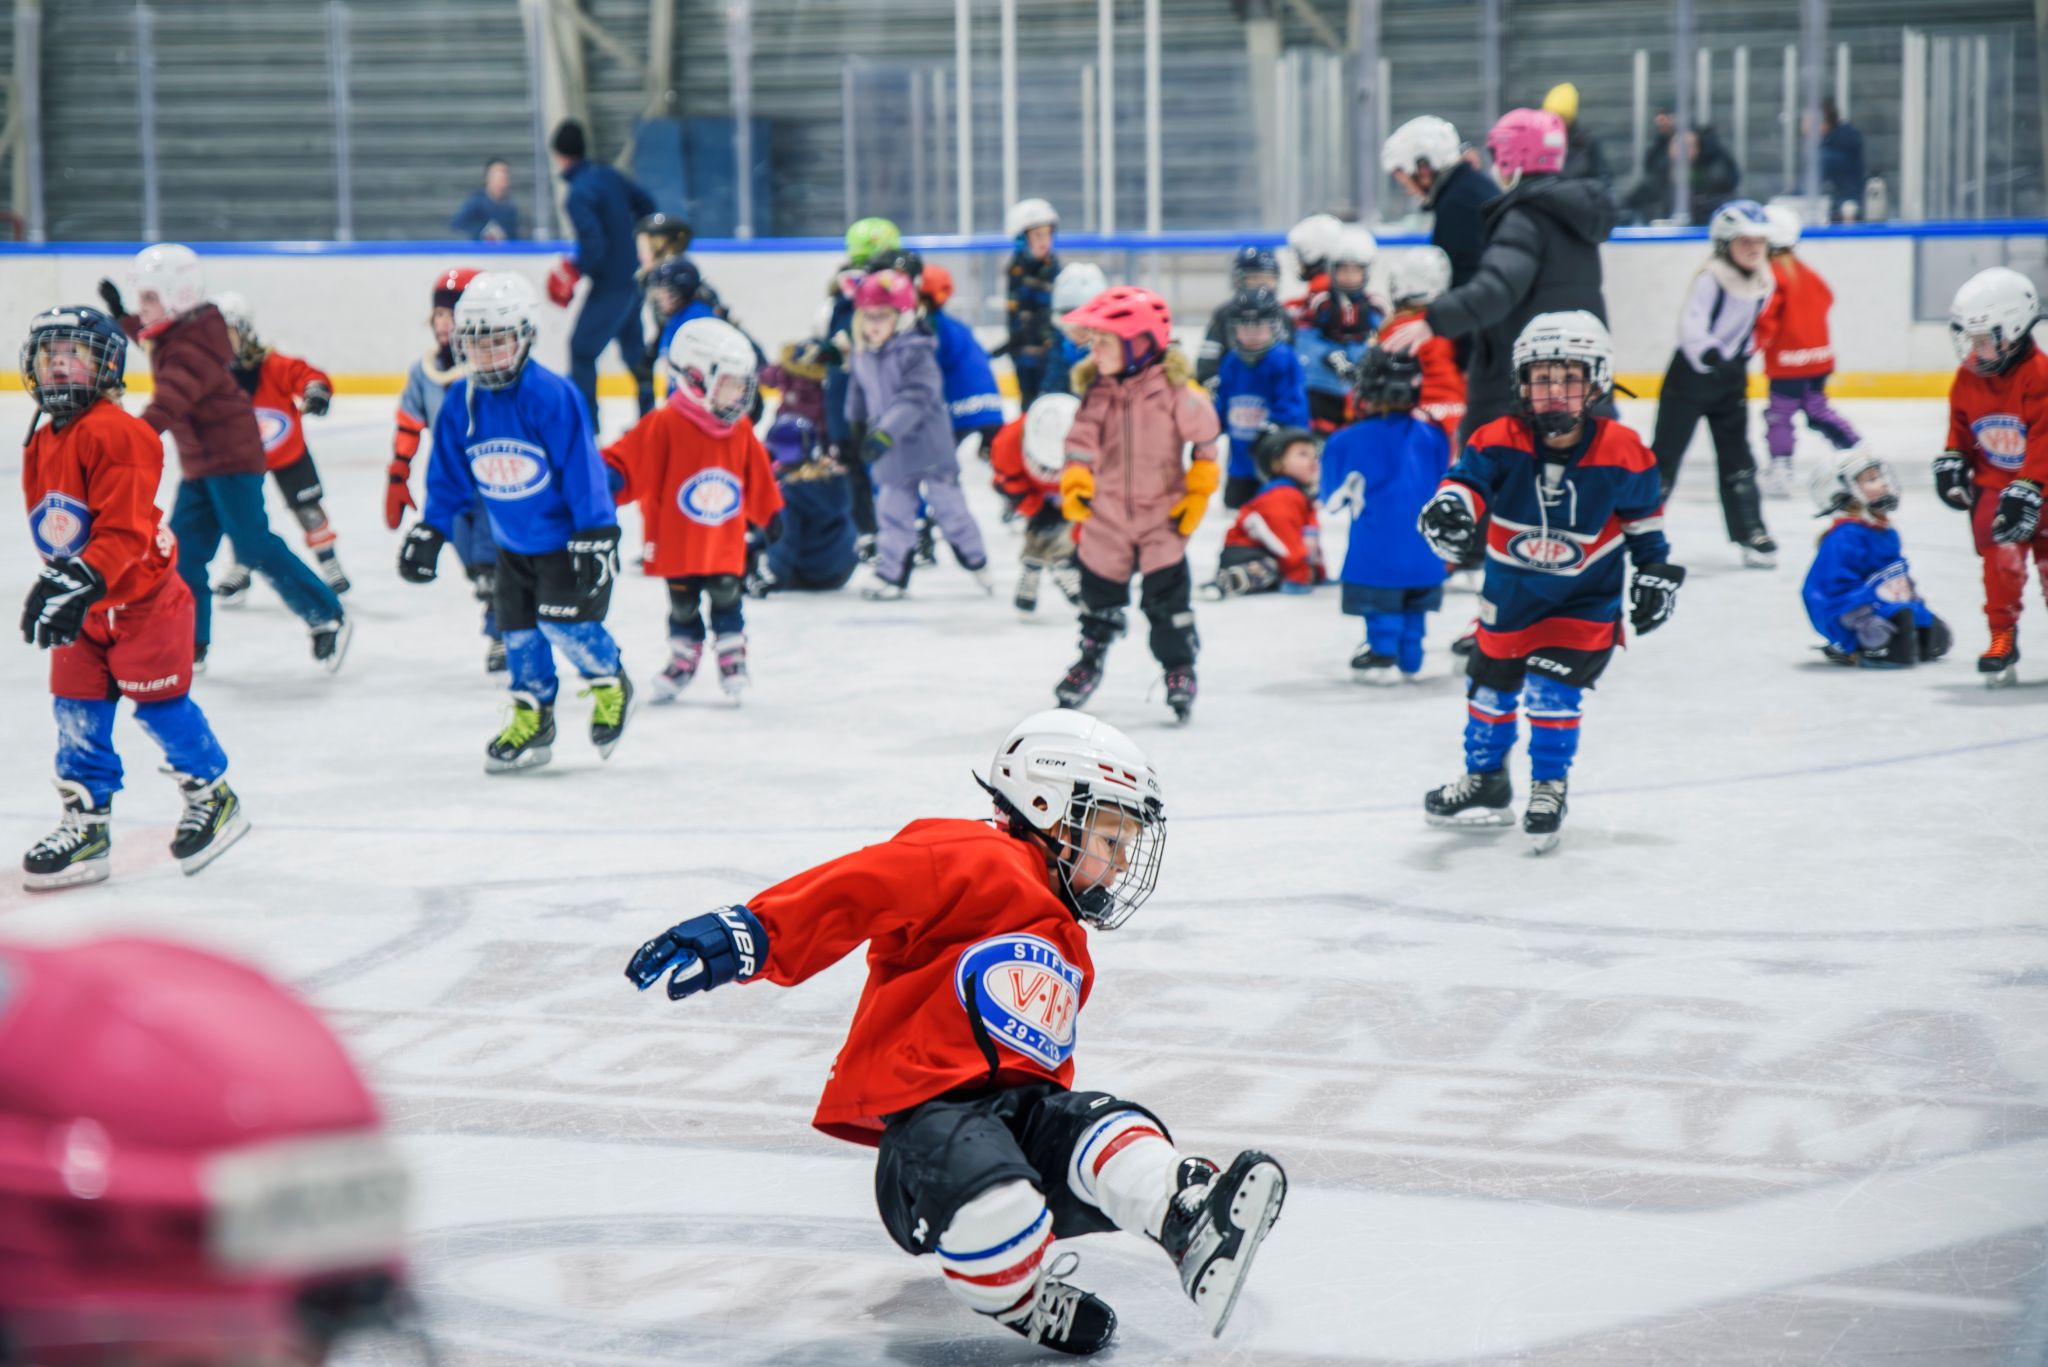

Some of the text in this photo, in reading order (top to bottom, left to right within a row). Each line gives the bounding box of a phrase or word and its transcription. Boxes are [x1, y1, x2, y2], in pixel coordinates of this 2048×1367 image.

[538, 603, 579, 618] CCM
[1526, 655, 1572, 677] CCM
[1036, 757, 1066, 767] CCM
[1147, 777, 1161, 793] CC
[714, 905, 755, 977] UER
[1013, 943, 1081, 988] STIFTE
[1212, 1066, 1984, 1160] TEAM
